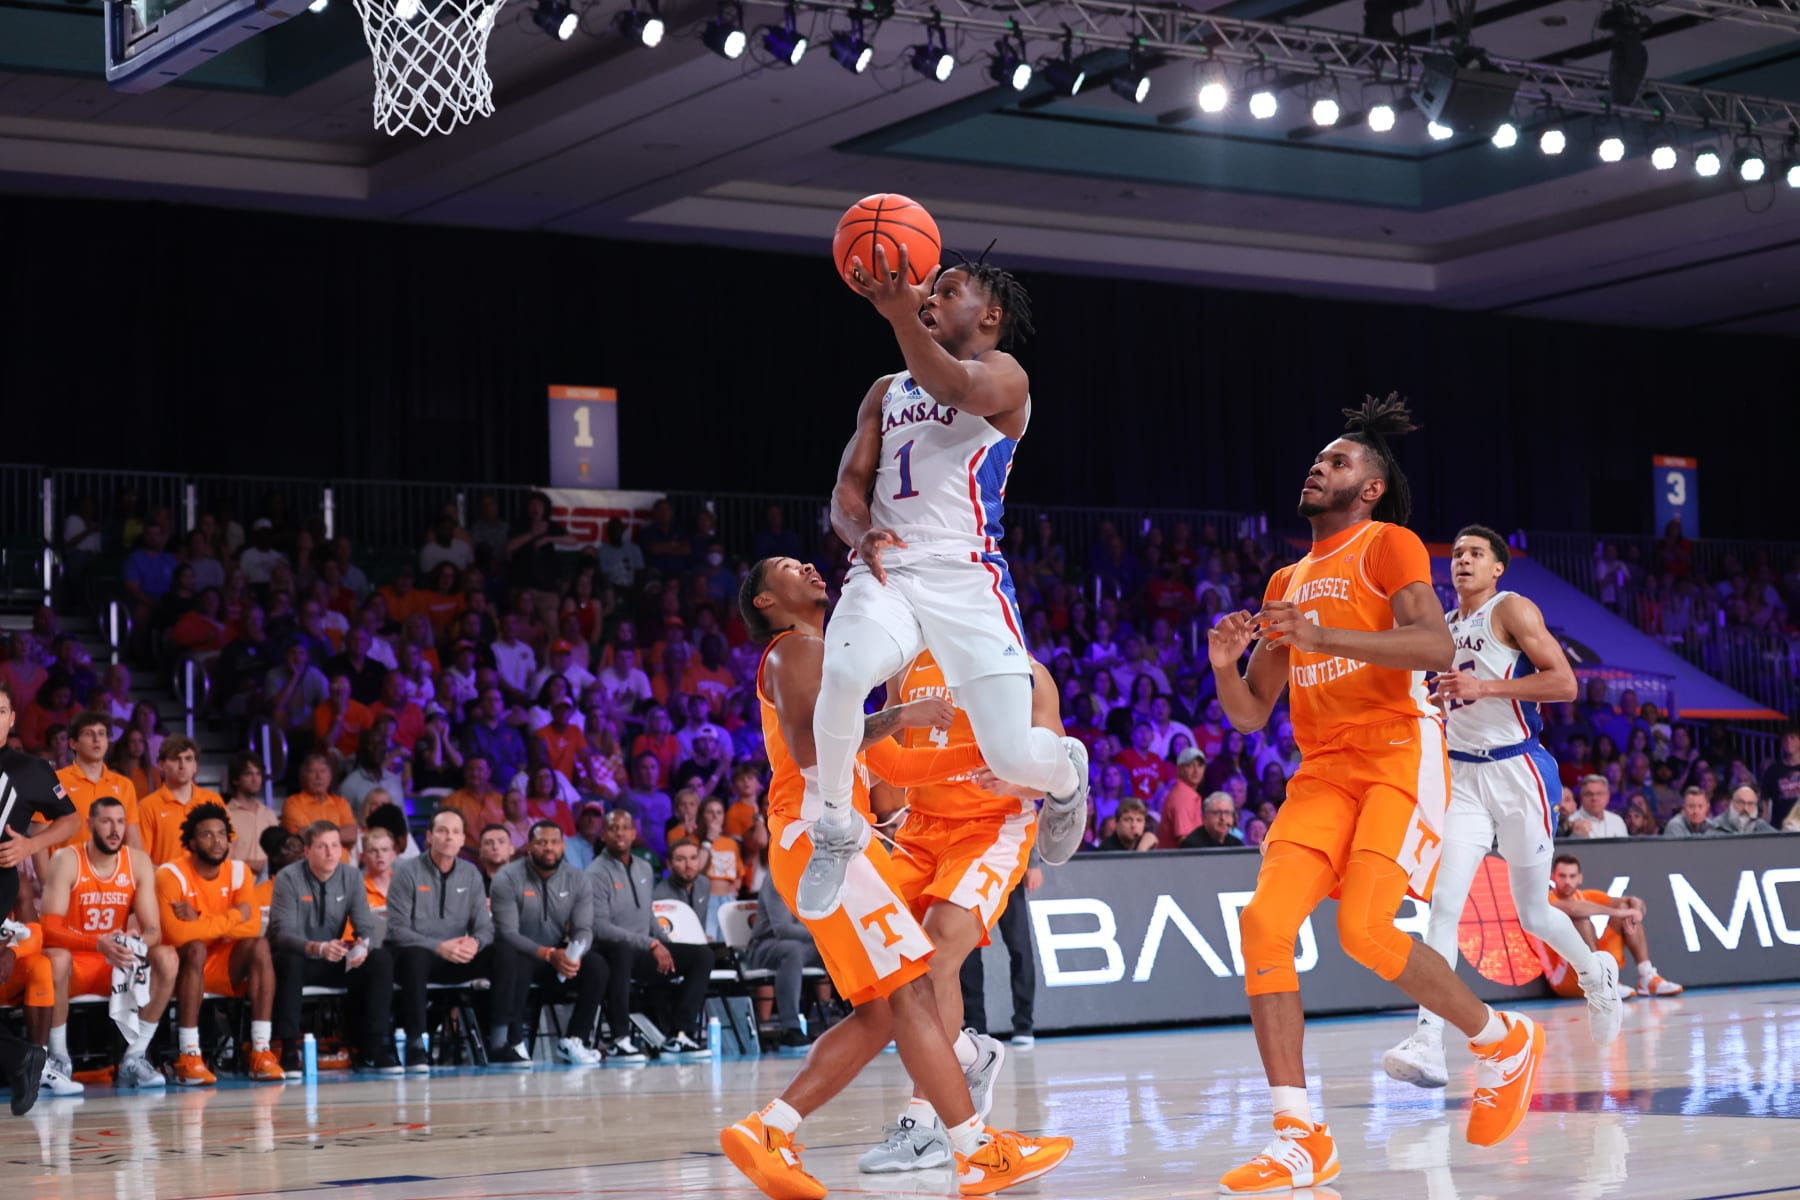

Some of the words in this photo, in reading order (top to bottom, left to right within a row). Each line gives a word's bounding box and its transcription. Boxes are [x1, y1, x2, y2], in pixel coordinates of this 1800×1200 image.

[573, 405, 595, 448] 1
[881, 401, 959, 437] ANSAS
[893, 439, 920, 500] 1
[1665, 471, 1687, 507] 3
[1289, 577, 1350, 606] NNESSEE
[1455, 634, 1485, 652] SAS
[1449, 659, 1477, 712] 5
[928, 724, 949, 749] 4
[1414, 817, 1442, 865] T
[975, 863, 1004, 902] T
[83, 907, 116, 931] 33
[859, 901, 903, 948] T
